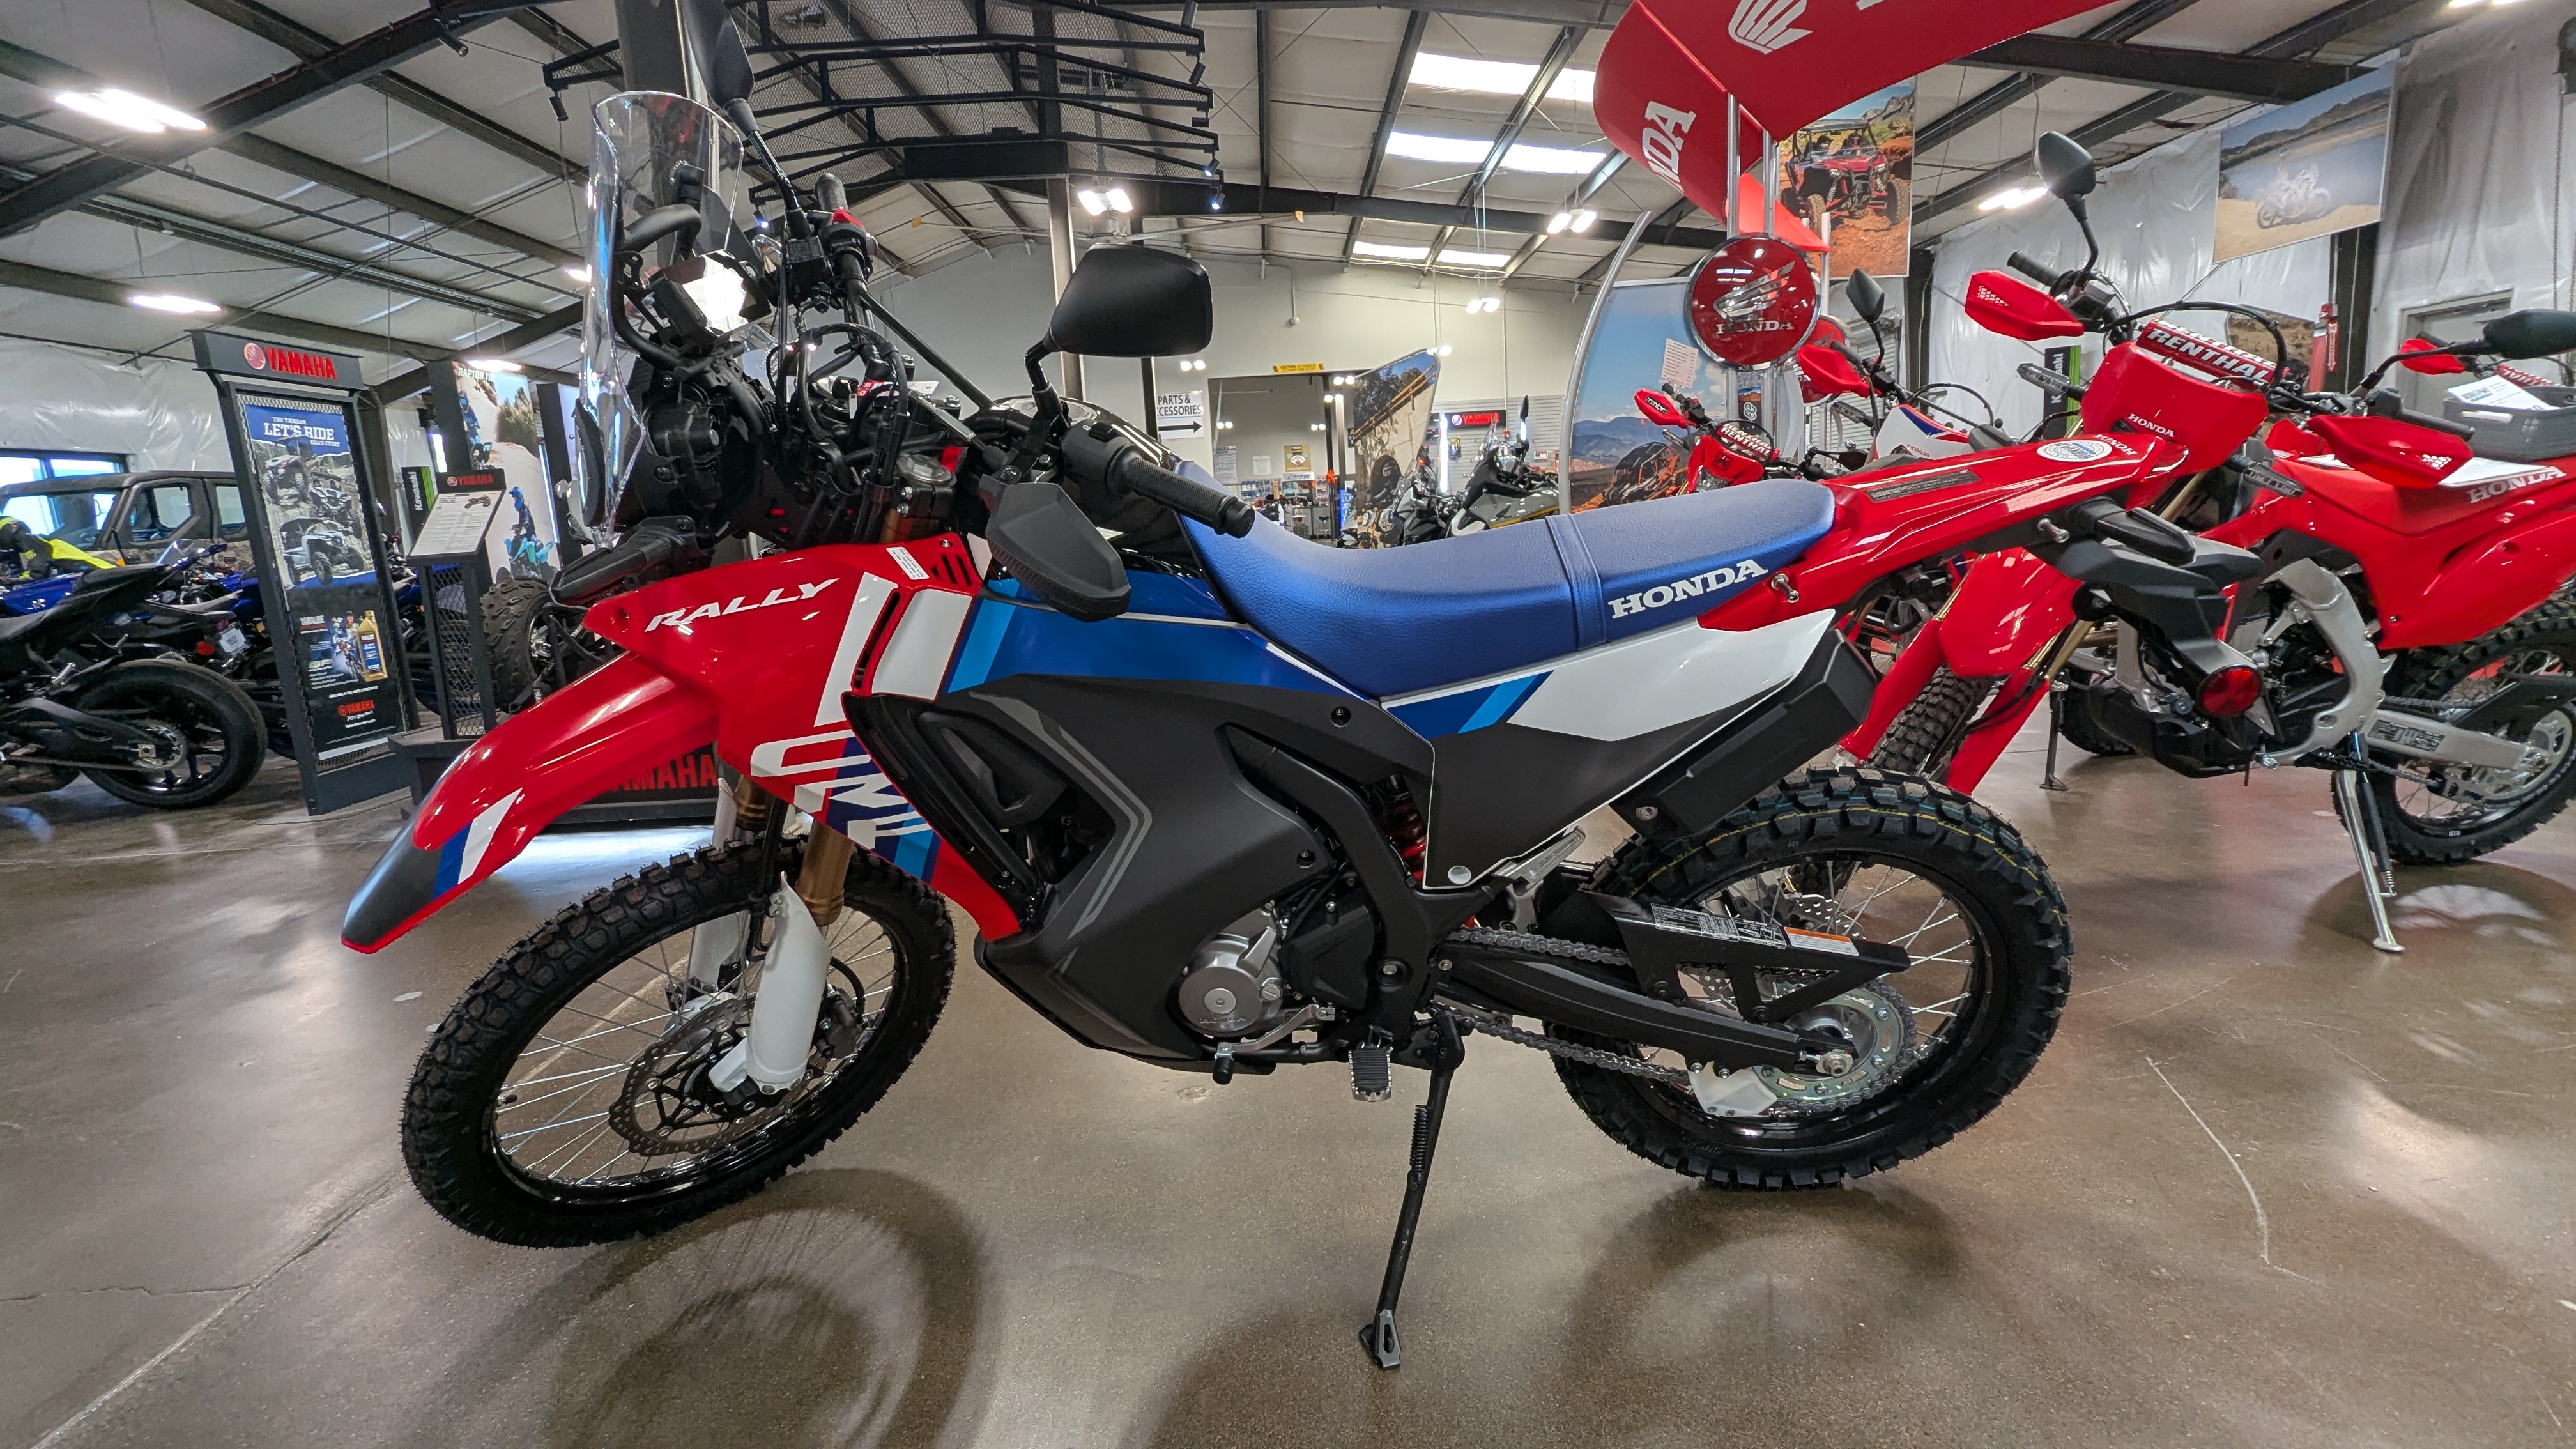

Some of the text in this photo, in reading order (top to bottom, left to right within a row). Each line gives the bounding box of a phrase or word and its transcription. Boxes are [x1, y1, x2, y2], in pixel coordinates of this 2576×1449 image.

[1715, 320, 1795, 335] HONDA
[264, 347, 337, 379] YAMAHA
[2147, 328, 2269, 381] RENTHAL
[458, 367, 484, 380] RAPTOR
[2051, 353, 2064, 404] Ksaki
[1158, 394, 1191, 405] PARTS &
[1463, 412, 1500, 424] YAMAHA
[2128, 413, 2175, 438] HONDA
[263, 422, 335, 441] LET'S RIDE
[1720, 427, 1771, 457] RENTHAL
[1906, 443, 1930, 458] HONDA
[408, 471, 424, 510] Kawasaki
[457, 473, 494, 486] YAMAHA
[2469, 466, 2567, 503] HONDA
[1607, 559, 1768, 618] HONDA
[644, 578, 840, 632] RALLY
[346, 700, 375, 714] YAMAHA
